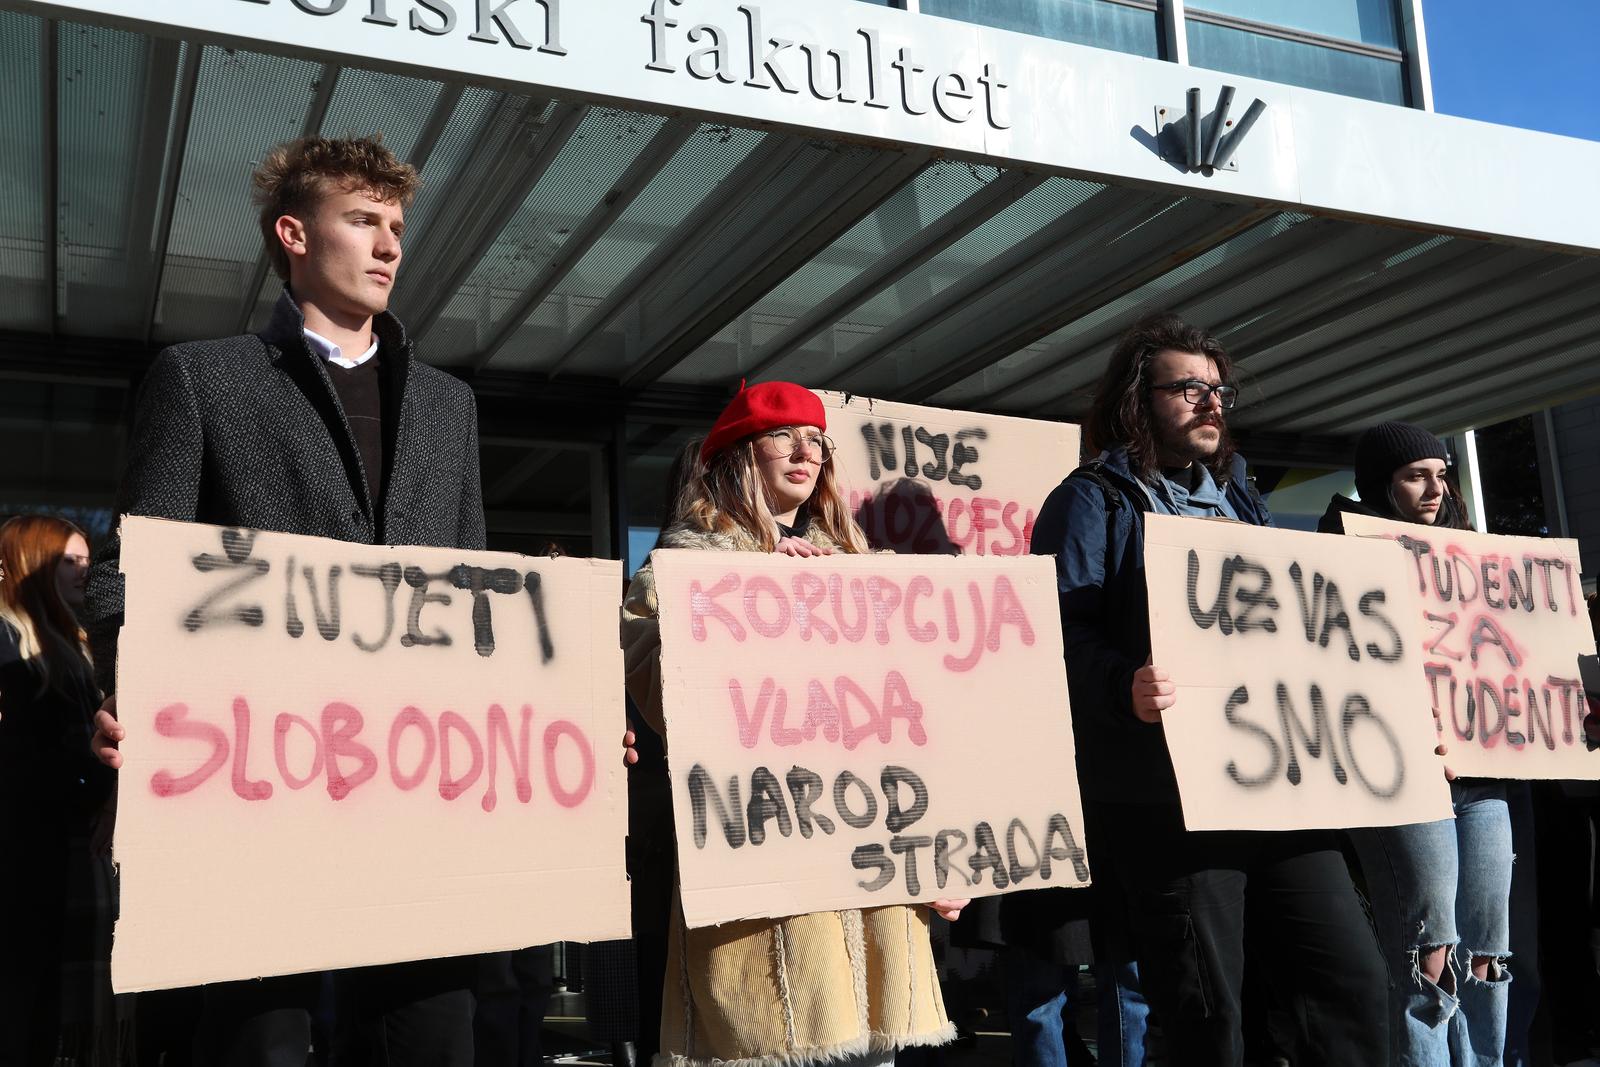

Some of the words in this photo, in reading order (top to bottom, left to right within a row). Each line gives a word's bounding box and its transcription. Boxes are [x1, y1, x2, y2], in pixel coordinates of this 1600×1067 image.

[641, 0, 1013, 130] fakultet
[860, 421, 988, 490] NIJE
[1287, 560, 1405, 664] VAS
[1395, 533, 1577, 617] TUDENTI
[689, 572, 1036, 673] KORUPCIJA
[1423, 609, 1525, 670] ZA
[150, 696, 597, 812] SLOBODNO
[728, 670, 928, 751] VLADA
[1223, 682, 1406, 800] SMO
[687, 763, 929, 850] NAROD
[850, 813, 1091, 896] STRADA
